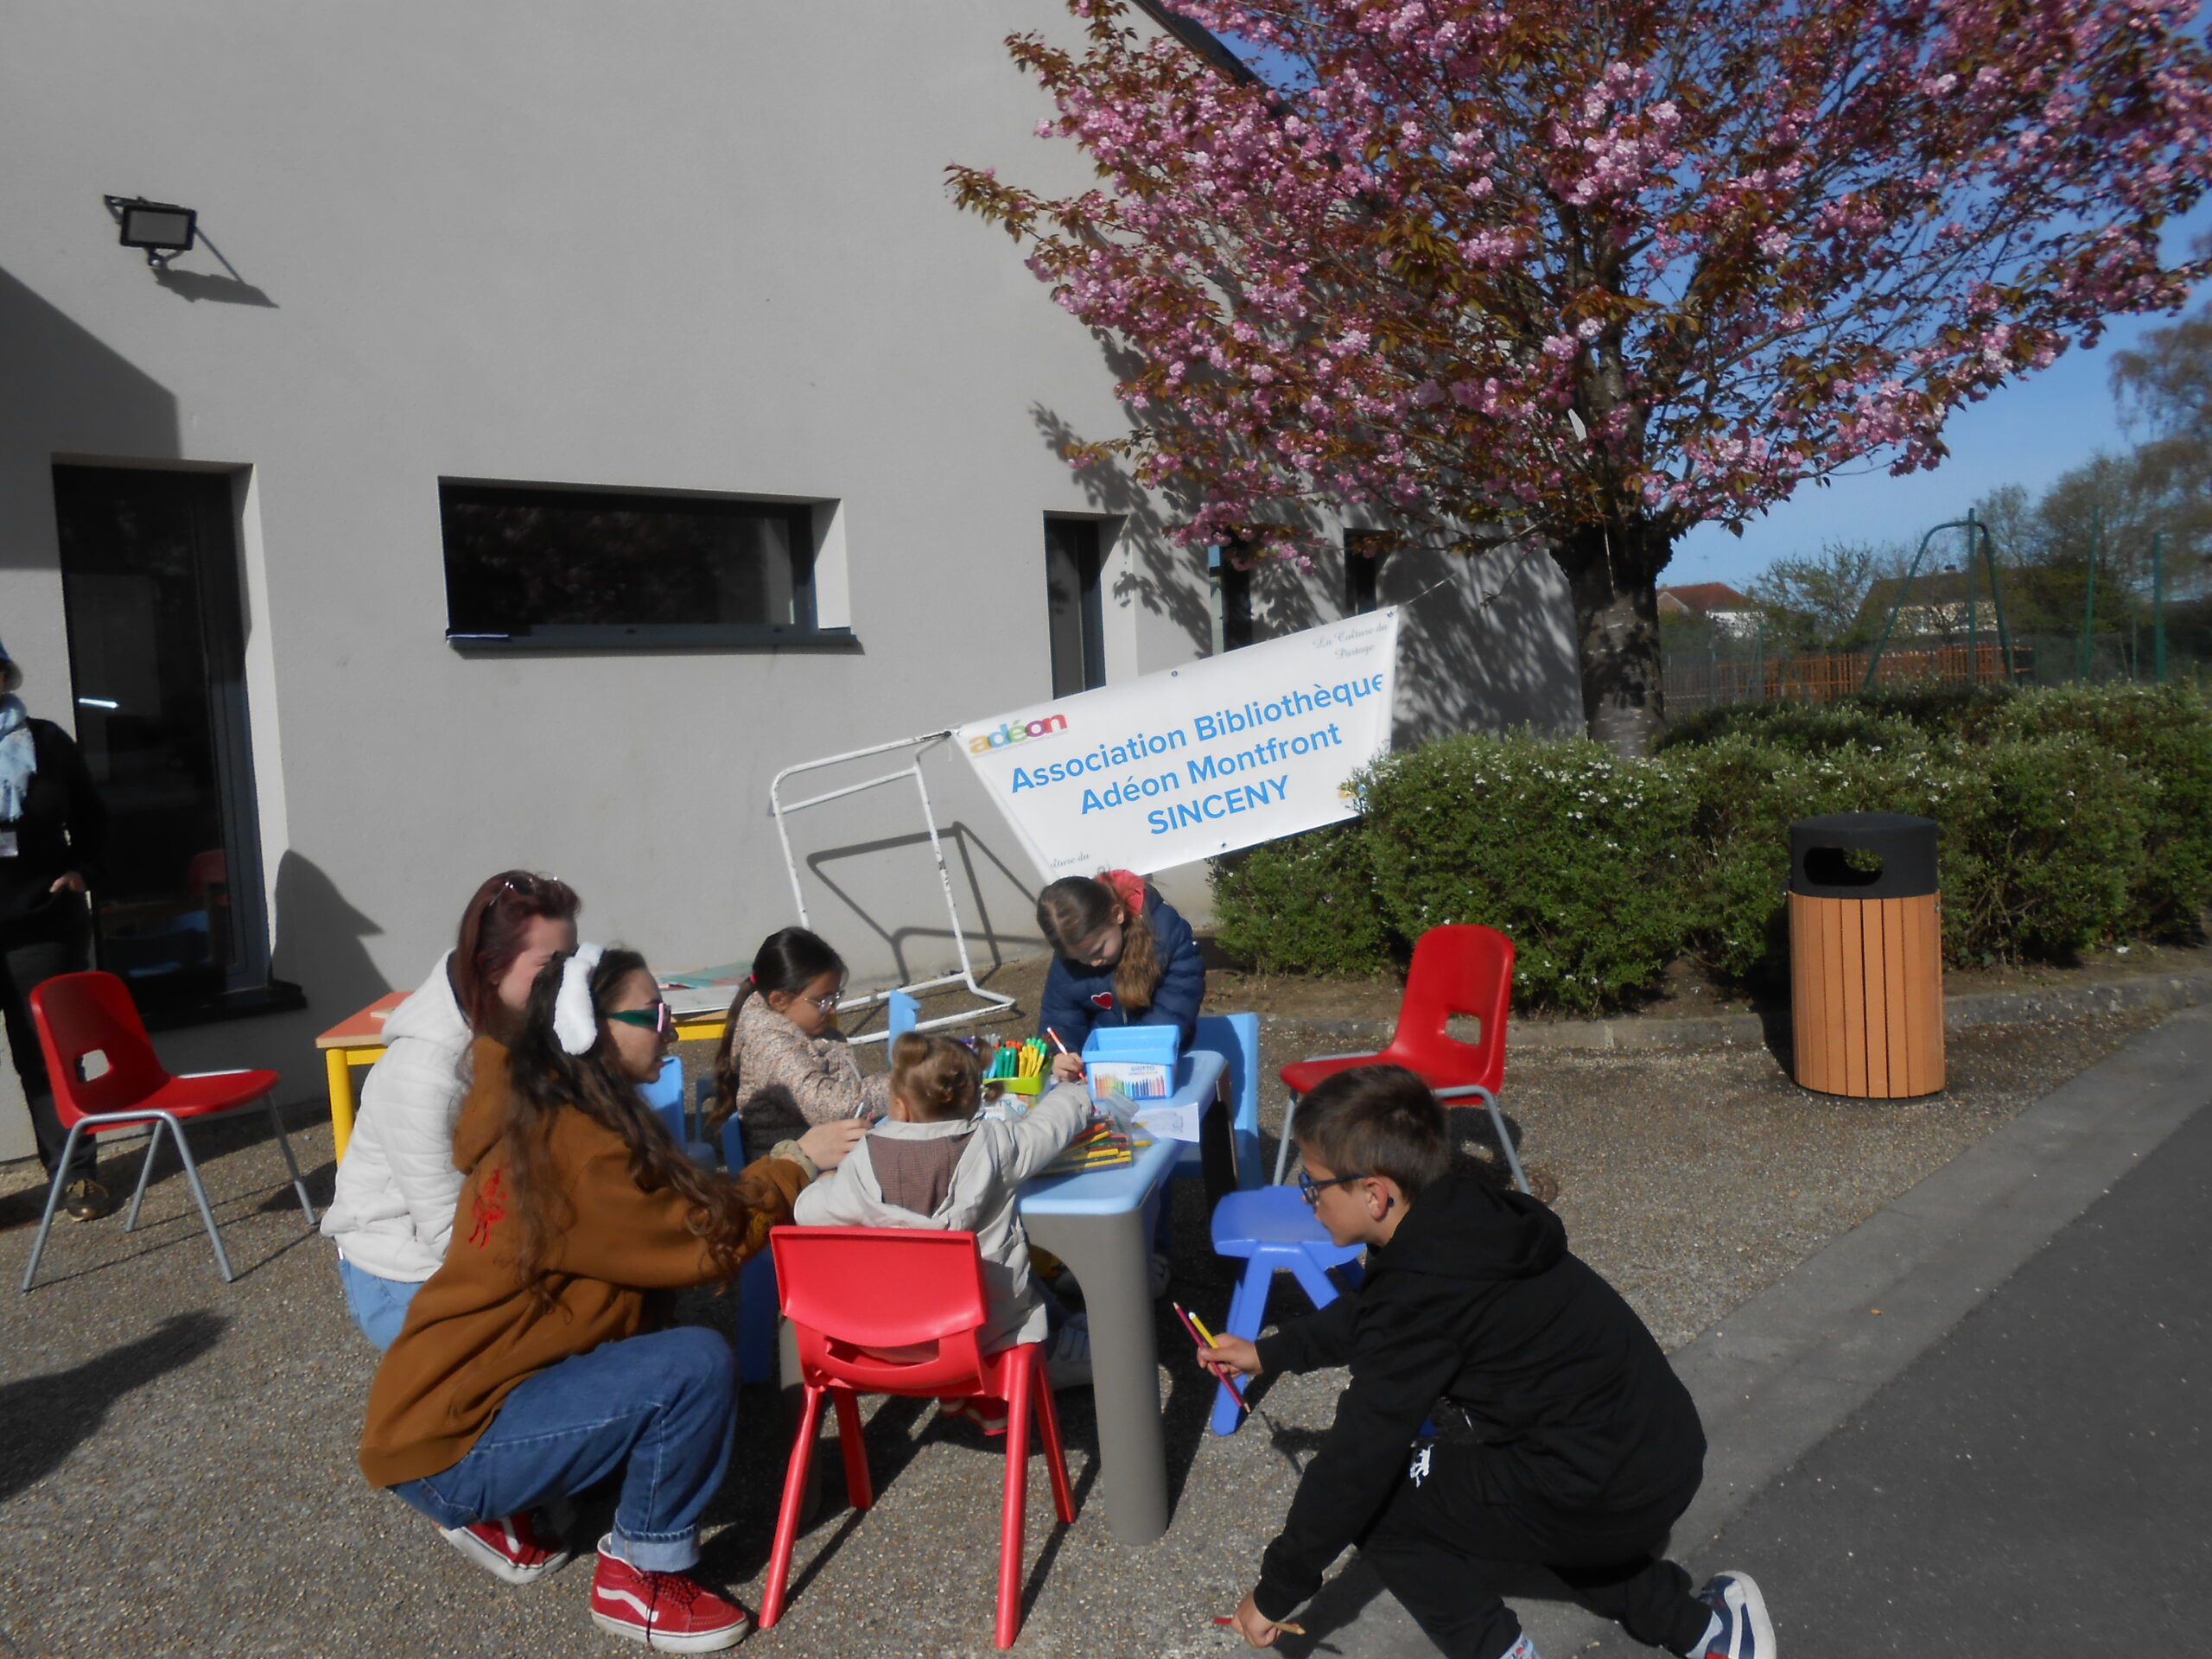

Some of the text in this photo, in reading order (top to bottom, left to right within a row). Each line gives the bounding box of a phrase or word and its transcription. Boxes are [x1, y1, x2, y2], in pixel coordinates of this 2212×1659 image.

[968, 714, 1068, 754] adéon
[1011, 728, 1187, 794] Association
[1194, 673, 1383, 742] Bibliothèque
[1081, 723, 1343, 815] Adéon Montfront
[1147, 774, 1289, 835] SINCENY
